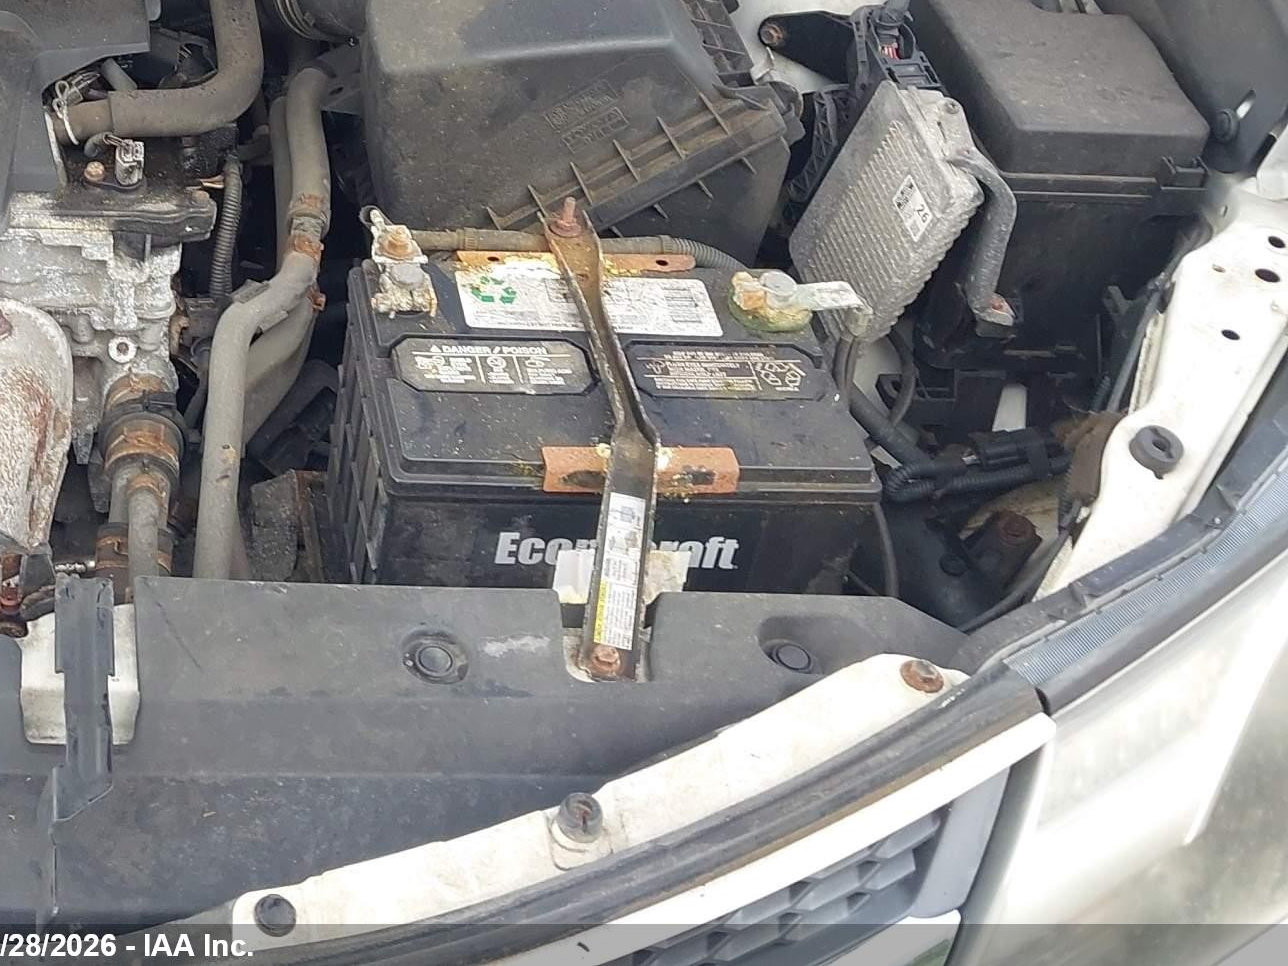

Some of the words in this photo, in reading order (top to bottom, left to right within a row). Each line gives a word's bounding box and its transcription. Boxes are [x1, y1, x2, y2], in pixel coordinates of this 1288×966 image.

[442, 345, 491, 354] DANGER
[501, 346, 548, 355] POISON
[494, 532, 739, 569] Ecoaft
